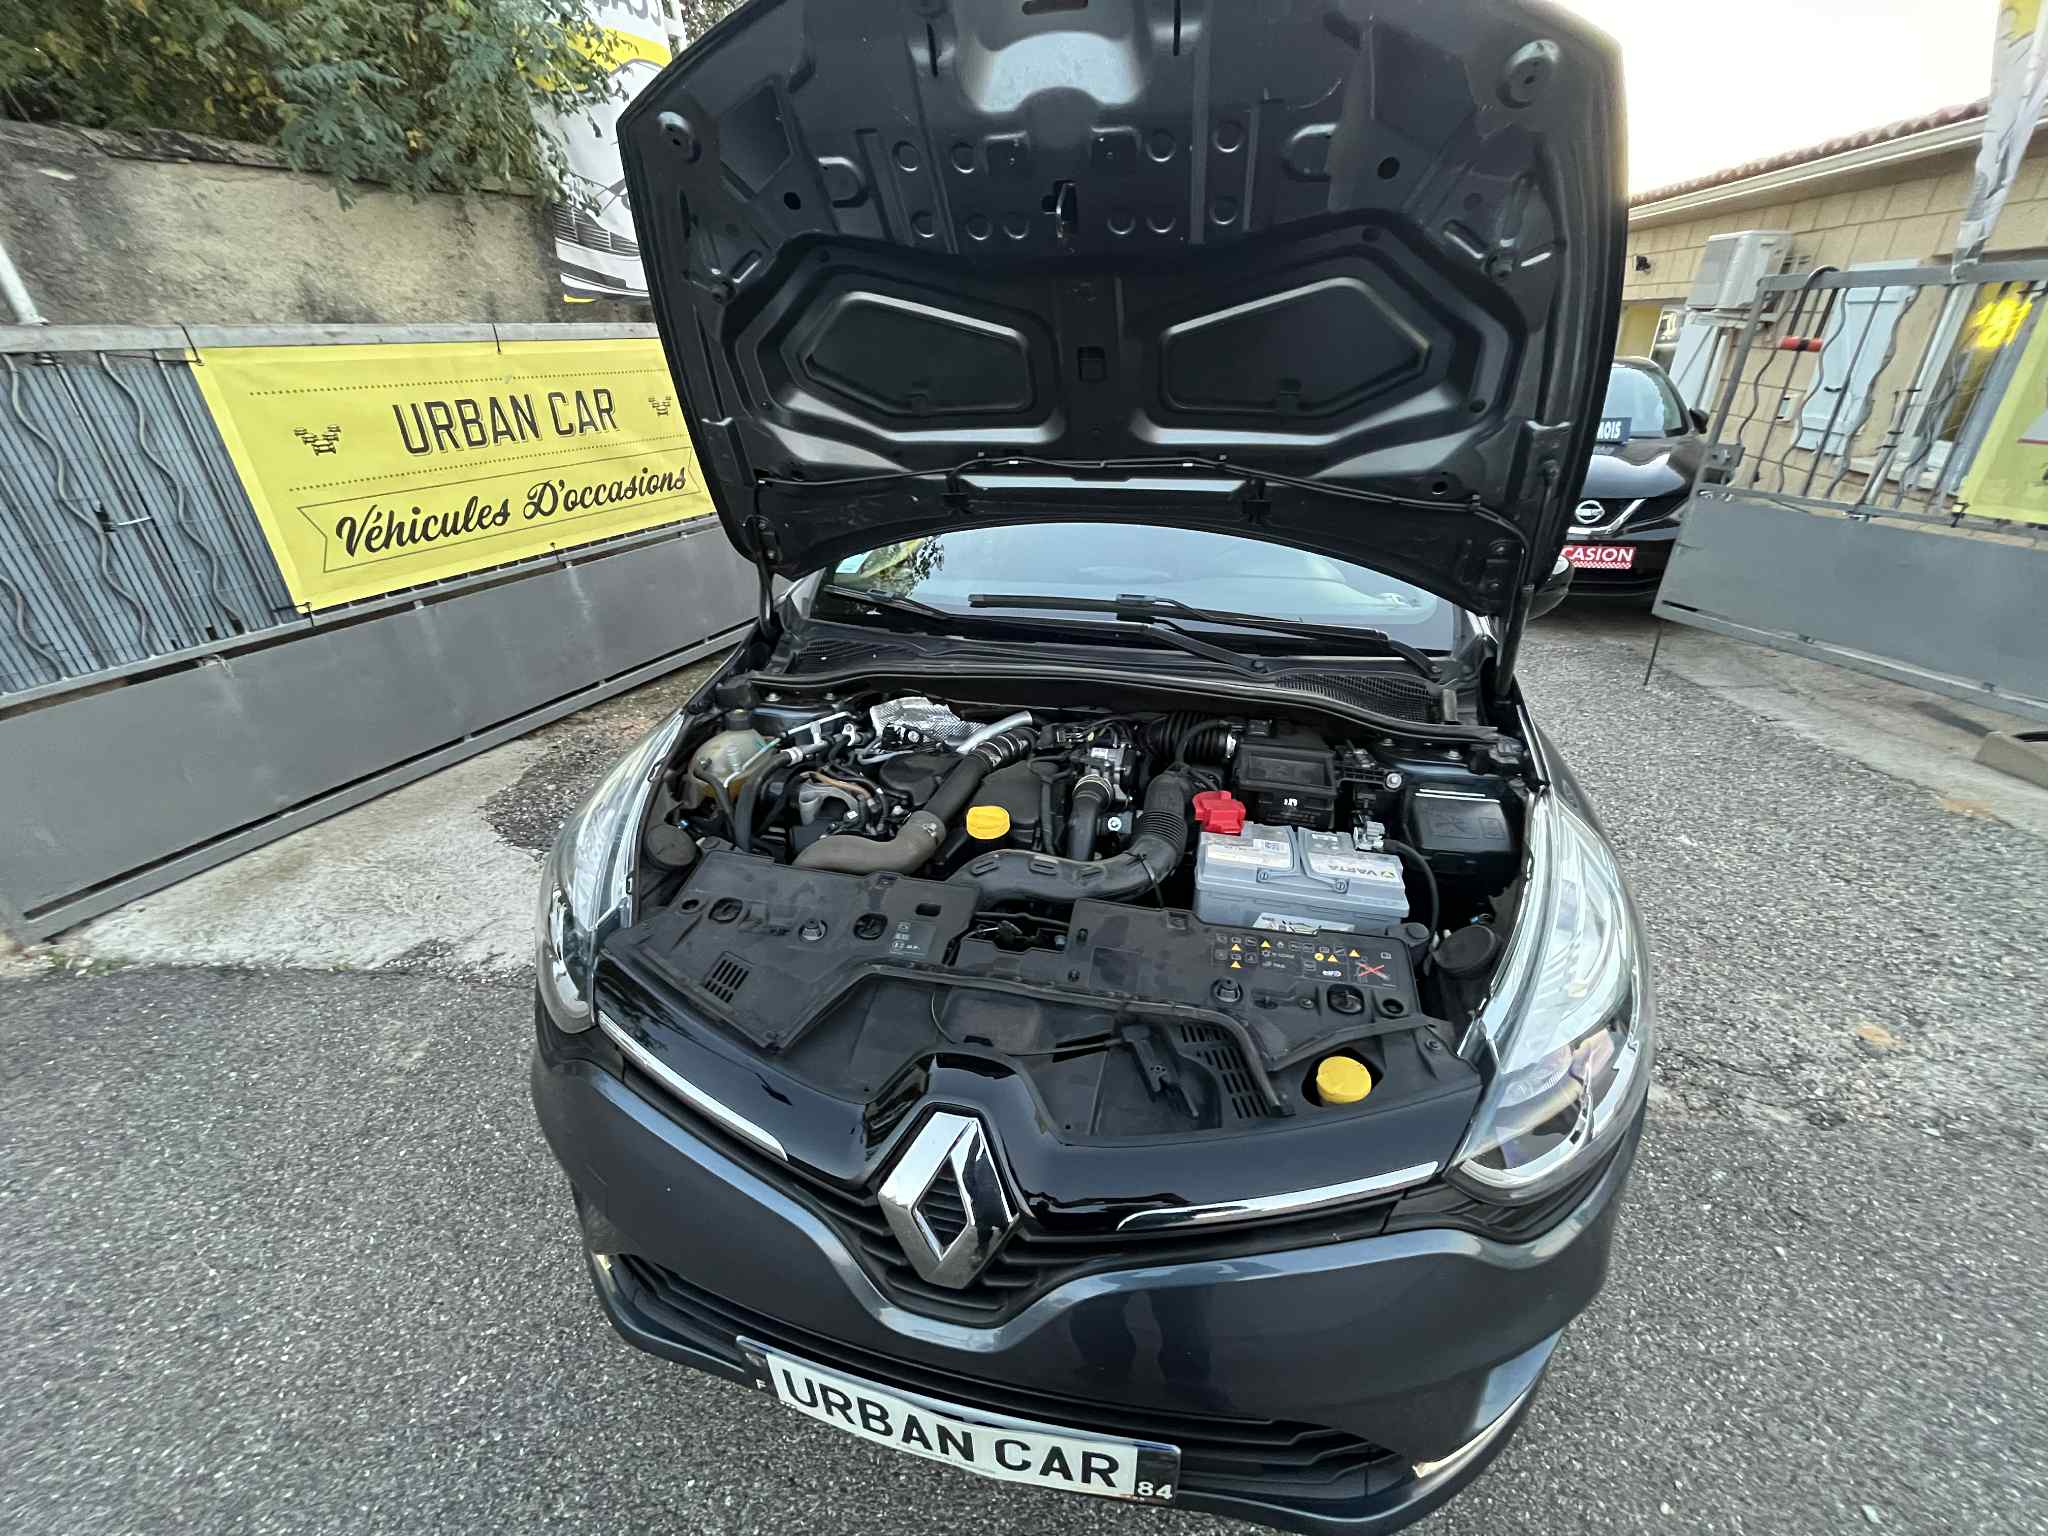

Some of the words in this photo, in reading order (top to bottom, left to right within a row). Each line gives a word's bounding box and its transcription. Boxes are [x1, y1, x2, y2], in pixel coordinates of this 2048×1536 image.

[392, 394, 542, 457] URBAN
[547, 388, 620, 438] CAR
[335, 495, 510, 557] Véhicules
[523, 466, 686, 520] D'occasions
[782, 1368, 975, 1462] URBAN
[994, 1438, 1120, 1488] CAR
[1137, 1481, 1173, 1500] 84
